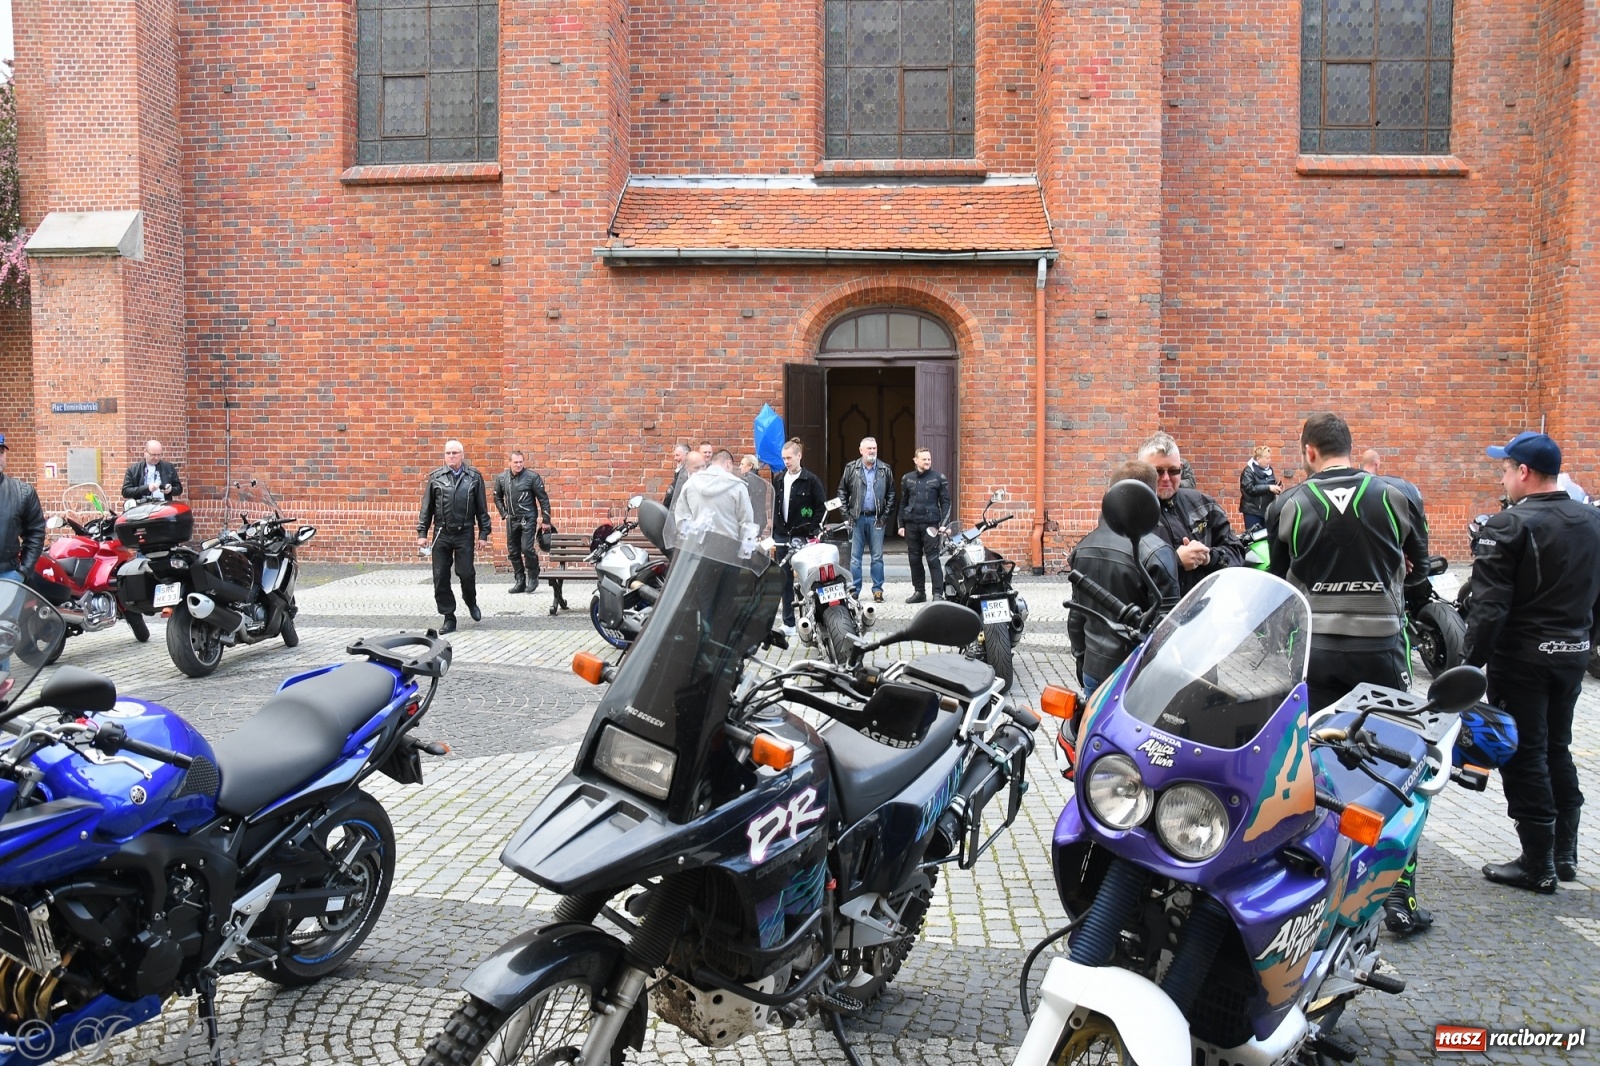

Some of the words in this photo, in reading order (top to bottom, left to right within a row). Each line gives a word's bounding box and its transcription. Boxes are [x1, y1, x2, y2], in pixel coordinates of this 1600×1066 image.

[52, 403, 63, 412] Plac
[161, 586, 175, 594] SRC
[825, 585, 840, 594] SRC
[1312, 581, 1384, 592] DAINESE
[156, 593, 177, 602] HK33
[988, 601, 1004, 610] SRC
[984, 610, 1008, 619] HK71
[1149, 730, 1182, 748] HONDA
[1137, 738, 1176, 757] Africa
[1150, 752, 1175, 767] Twin
[746, 787, 826, 863] DR
